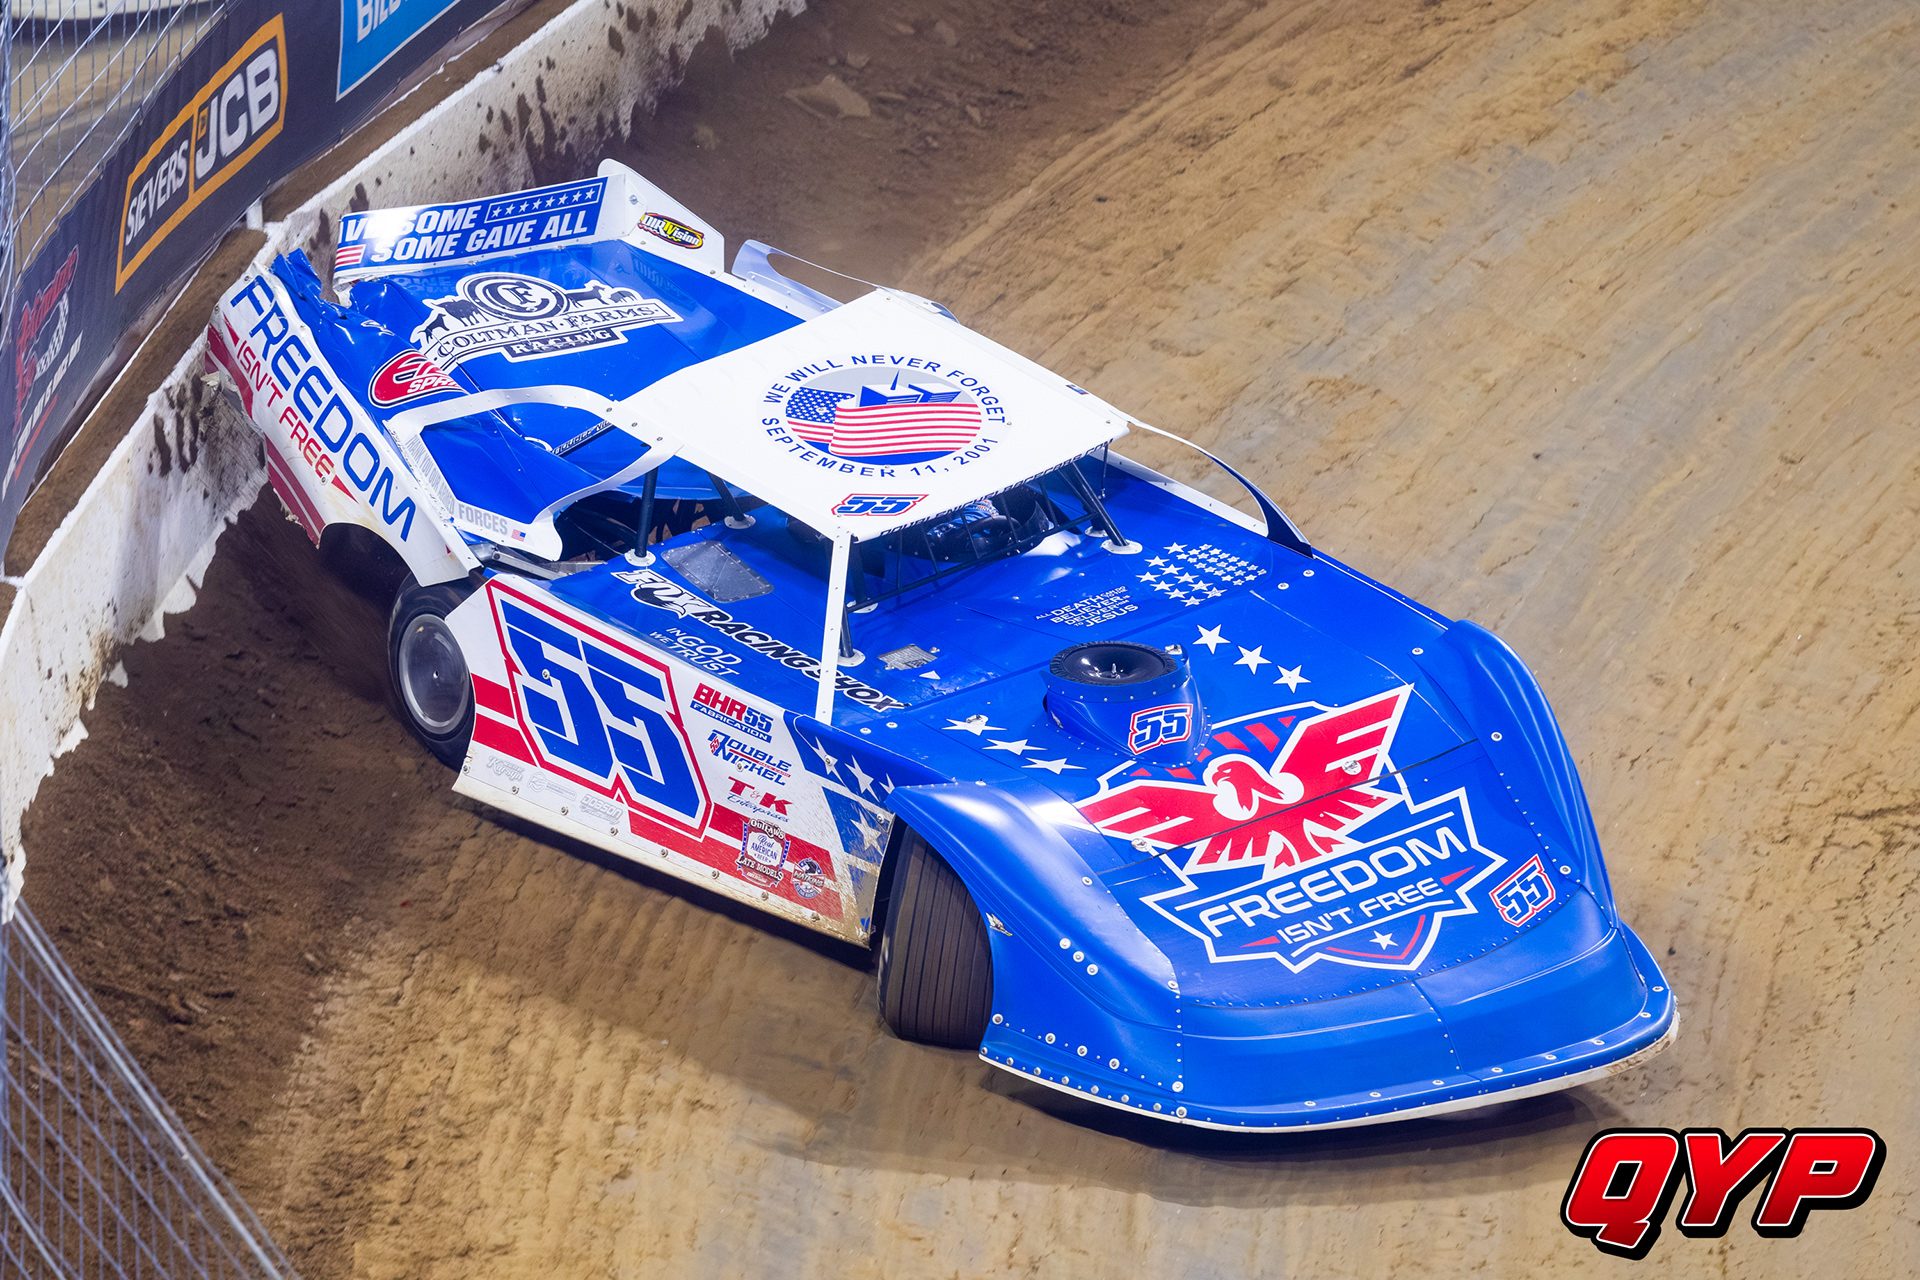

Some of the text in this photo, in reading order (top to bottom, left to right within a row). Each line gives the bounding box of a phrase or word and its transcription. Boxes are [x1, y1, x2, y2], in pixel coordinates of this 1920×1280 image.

[125, 48, 279, 246] SIEVERS JCB
[370, 210, 588, 262] SOME GAVE ALL
[438, 306, 654, 357] COLTMAN FARMS
[513, 329, 612, 354] RACING
[230, 275, 416, 542] FREEDOM
[237, 340, 335, 477] ISN'T FREE
[764, 354, 1006, 423] WE WILL NEVER FORGET
[762, 417, 896, 478] SEPTEMBER
[953, 437, 998, 465] 2001
[458, 502, 508, 537] FORCES
[834, 495, 925, 515] 55
[1050, 596, 1123, 623] BELIEVER
[1051, 595, 1104, 616] DEATH
[1064, 604, 1119, 625] DELIVER
[1086, 604, 1139, 627] JESUS
[649, 631, 740, 676] WE TRUST
[666, 627, 743, 665] IN GOD
[500, 598, 700, 820] 55
[692, 702, 770, 742] FABRICATION
[1131, 705, 1190, 751] 55
[708, 729, 792, 773] DOUBLE
[750, 819, 785, 840] OUTLAWS
[751, 842, 778, 861] AMERICAN
[756, 862, 785, 881] MODELS
[1199, 825, 1468, 937] FREEDOM
[1491, 856, 1553, 924] 55
[1277, 877, 1444, 944] ISN'T FREE
